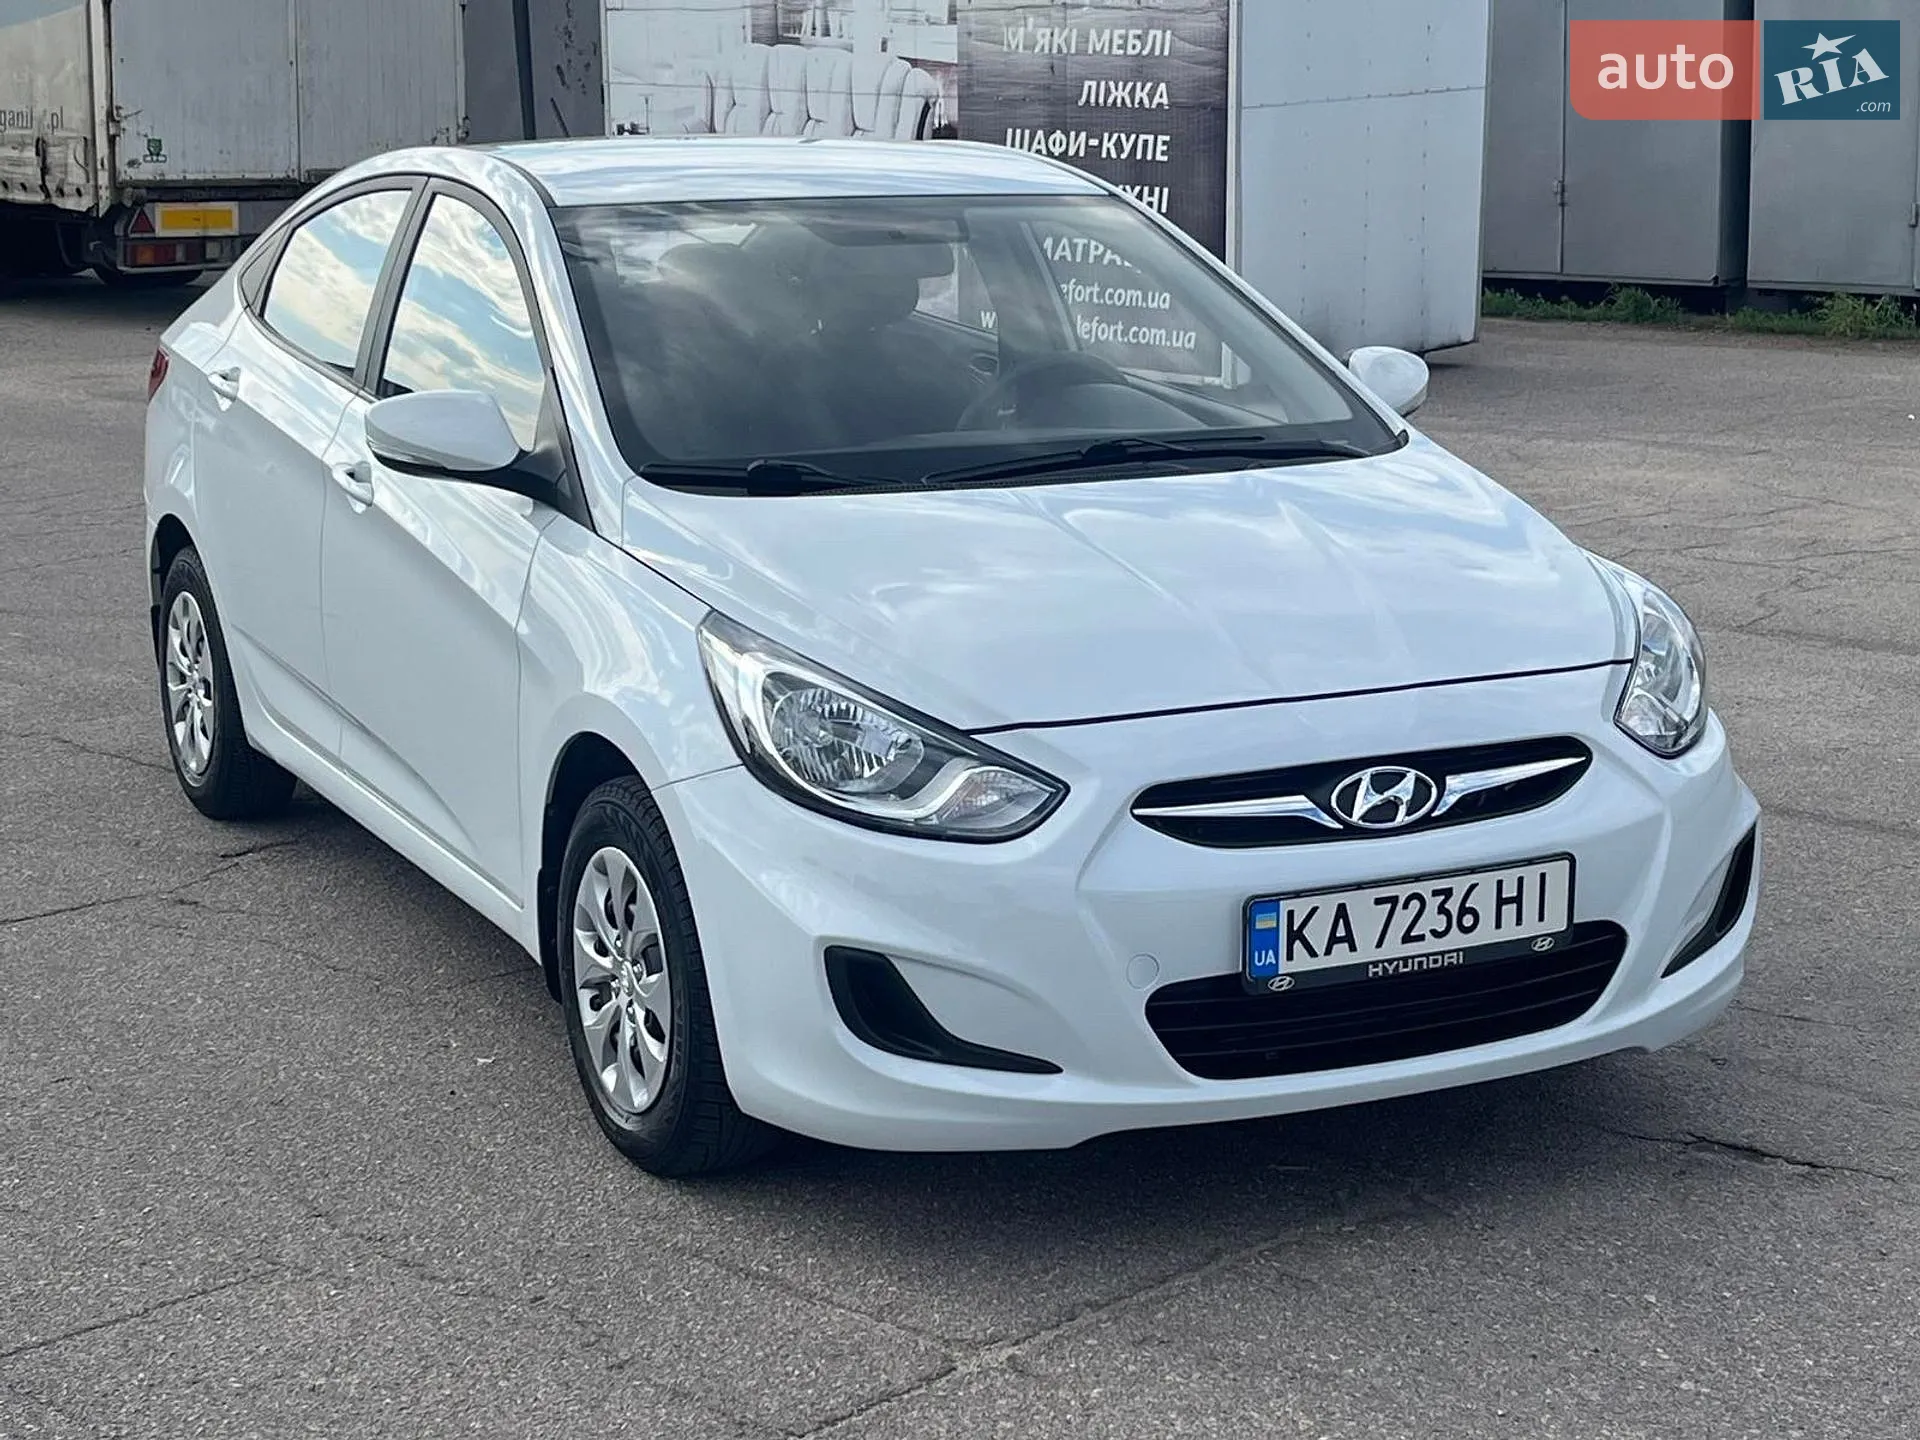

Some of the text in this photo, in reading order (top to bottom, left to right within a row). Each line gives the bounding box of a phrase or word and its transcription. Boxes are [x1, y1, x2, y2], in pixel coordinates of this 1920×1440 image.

[1087, 29, 1172, 56] МЕБЛІ
[1078, 80, 1170, 109] ЛІЖКА
[1006, 128, 1170, 161] ШАФИ-КУПЕ
[1285, 871, 1547, 962] KA 7236 HI
[1254, 950, 1276, 967] UA
[1368, 952, 1463, 978] HYUNDAI
